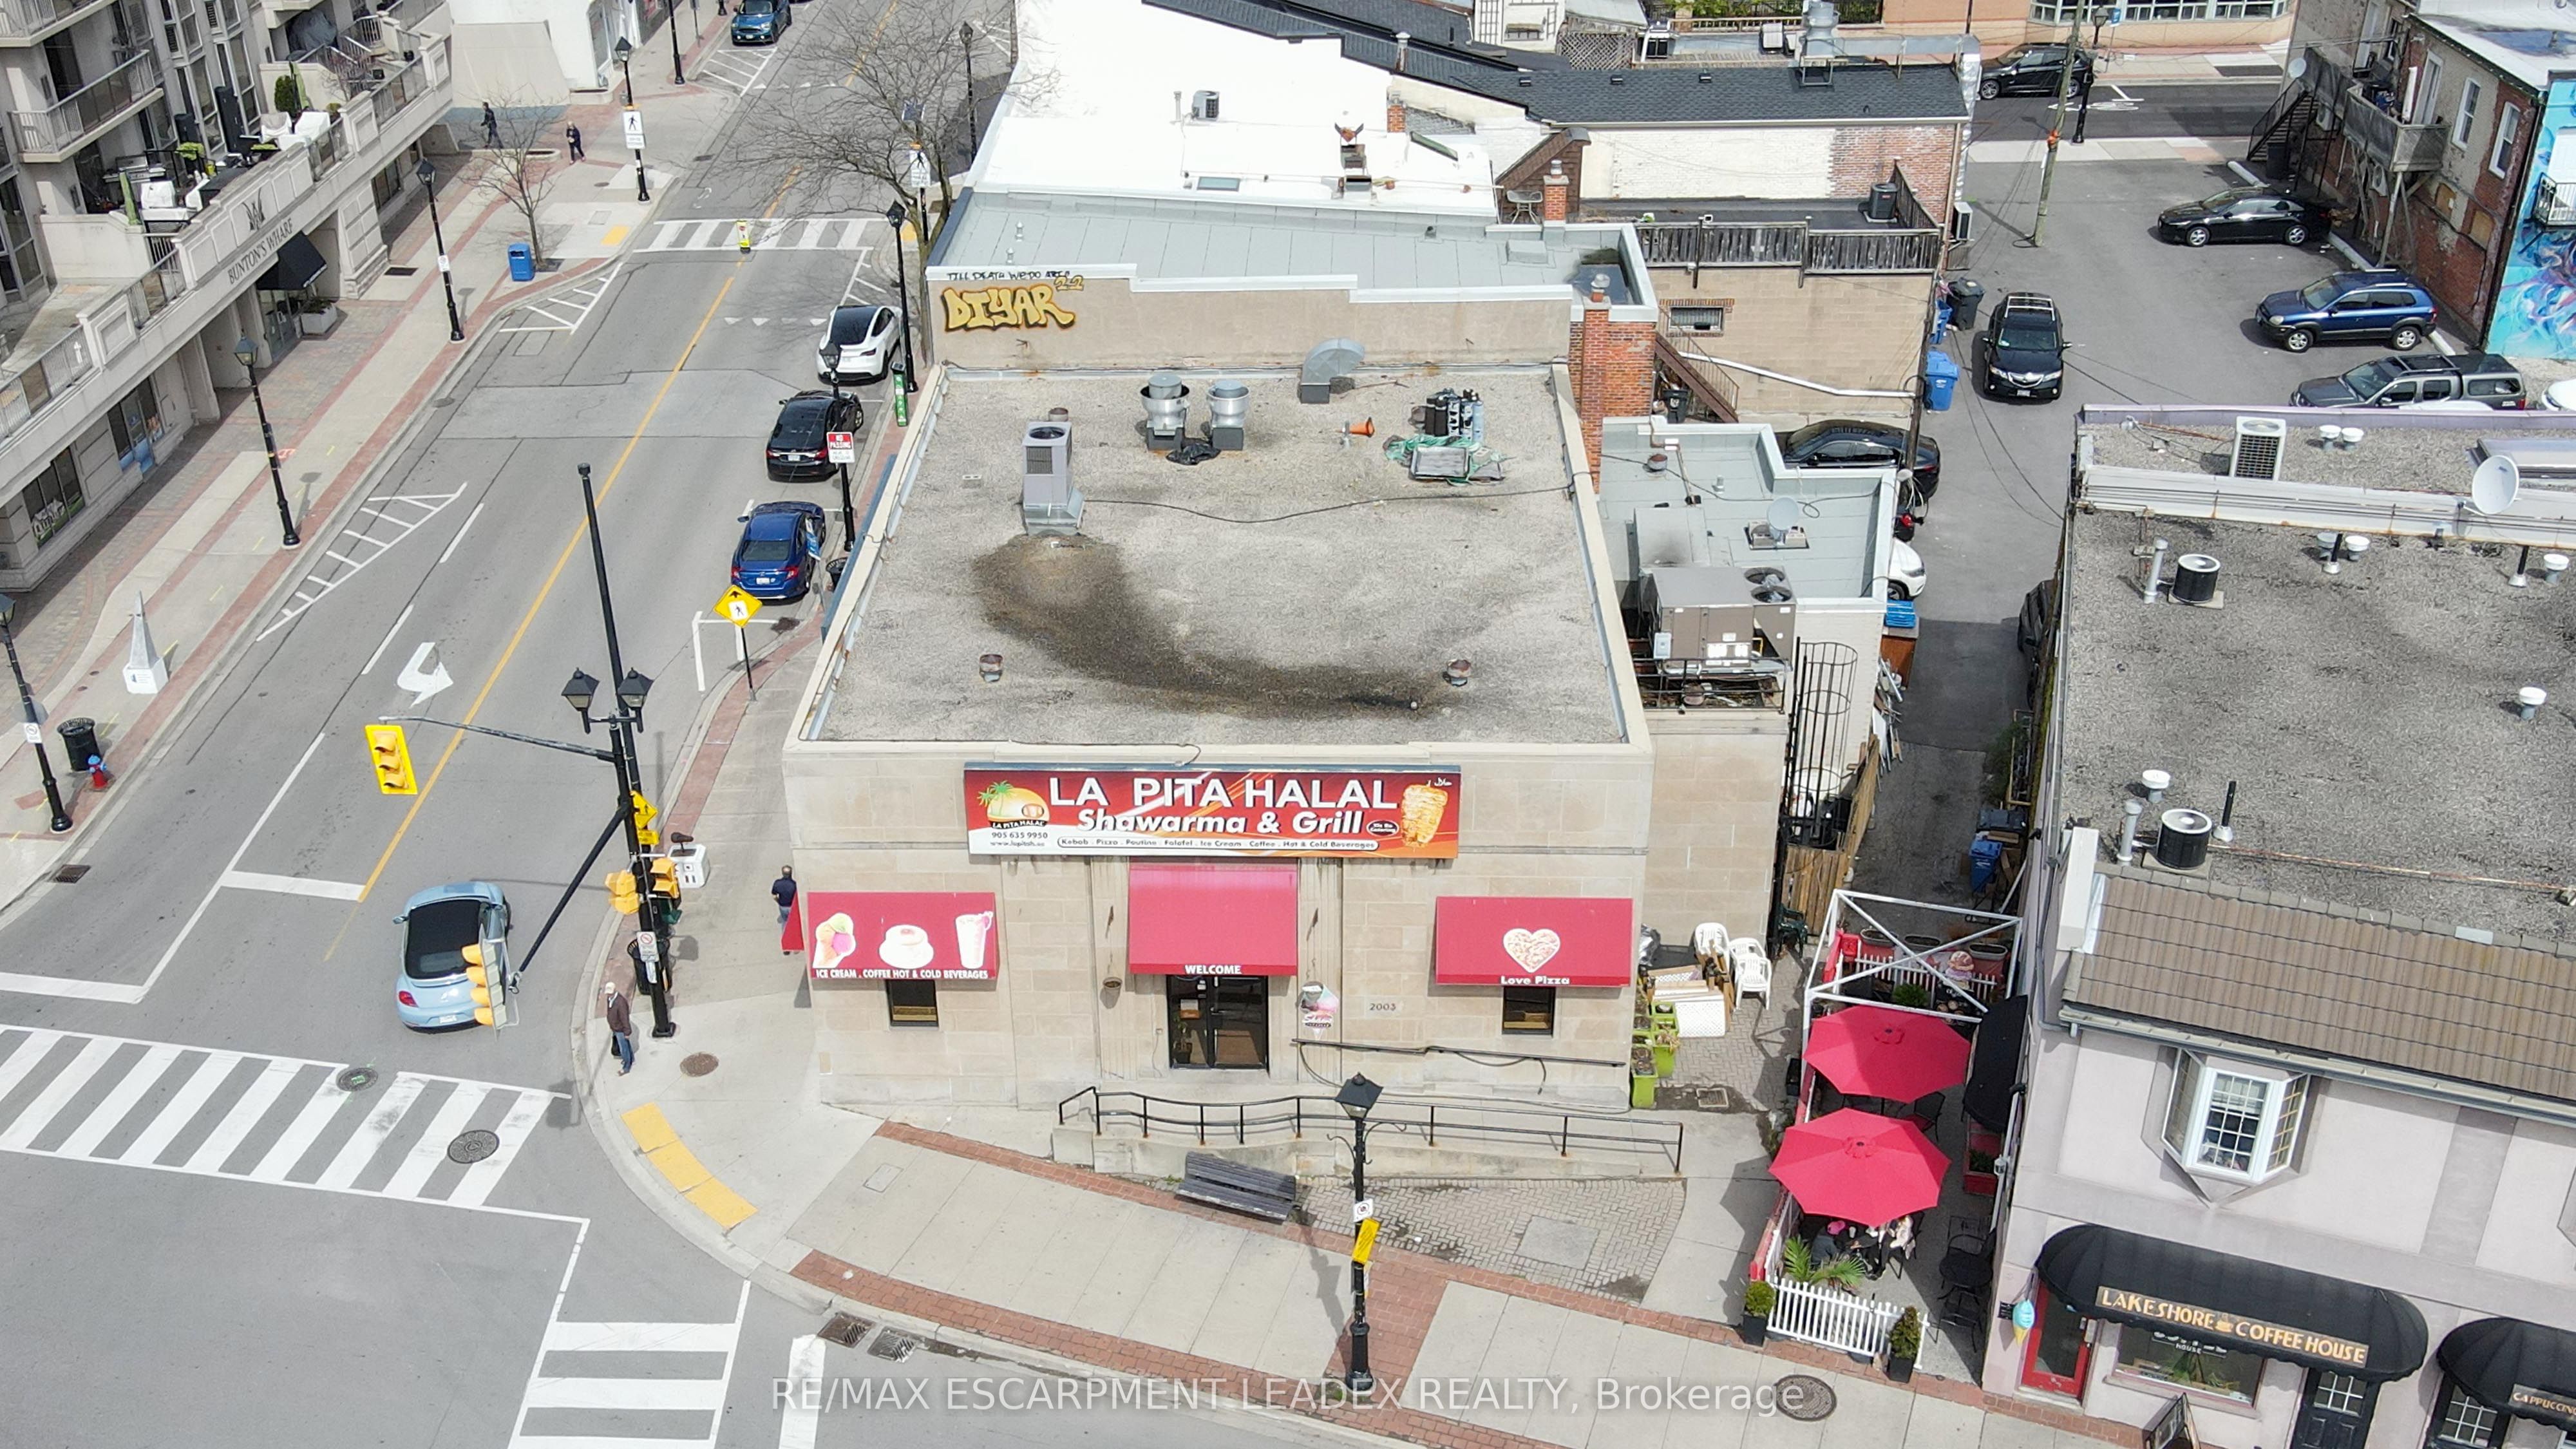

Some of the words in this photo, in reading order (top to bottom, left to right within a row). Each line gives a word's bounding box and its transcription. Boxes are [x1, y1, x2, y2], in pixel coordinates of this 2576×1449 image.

[227, 241, 267, 284] BUNTON'S
[266, 218, 293, 251] WHARF
[940, 284, 1075, 331] DIYAR
[1050, 777, 1110, 806] LA
[1133, 777, 1234, 808] PITA
[1245, 779, 1399, 809] HALAL
[1077, 808, 1246, 833] Shawarma
[1256, 811, 1281, 833] &
[1293, 810, 1363, 834] Grill
[816, 970, 828, 978] ICE
[830, 970, 857, 978] CREAM
[863, 970, 891, 978] COFFEE
[893, 970, 909, 978] HOT
[912, 970, 918, 978] &
[920, 970, 942, 979] COLD
[943, 971, 989, 980] BEVERAGES
[1184, 965, 1242, 975] WELCOME
[1501, 975, 1531, 985] Love
[1535, 975, 1570, 985] Pizza
[1369, 1003, 1396, 1011] 2003
[2101, 1289, 2215, 1331] LAKESHORE
[2235, 1321, 2304, 1350] COFFEE
[2305, 1336, 2366, 1364] HOUSE
[2175, 1343, 2202, 1355] HOUSE
